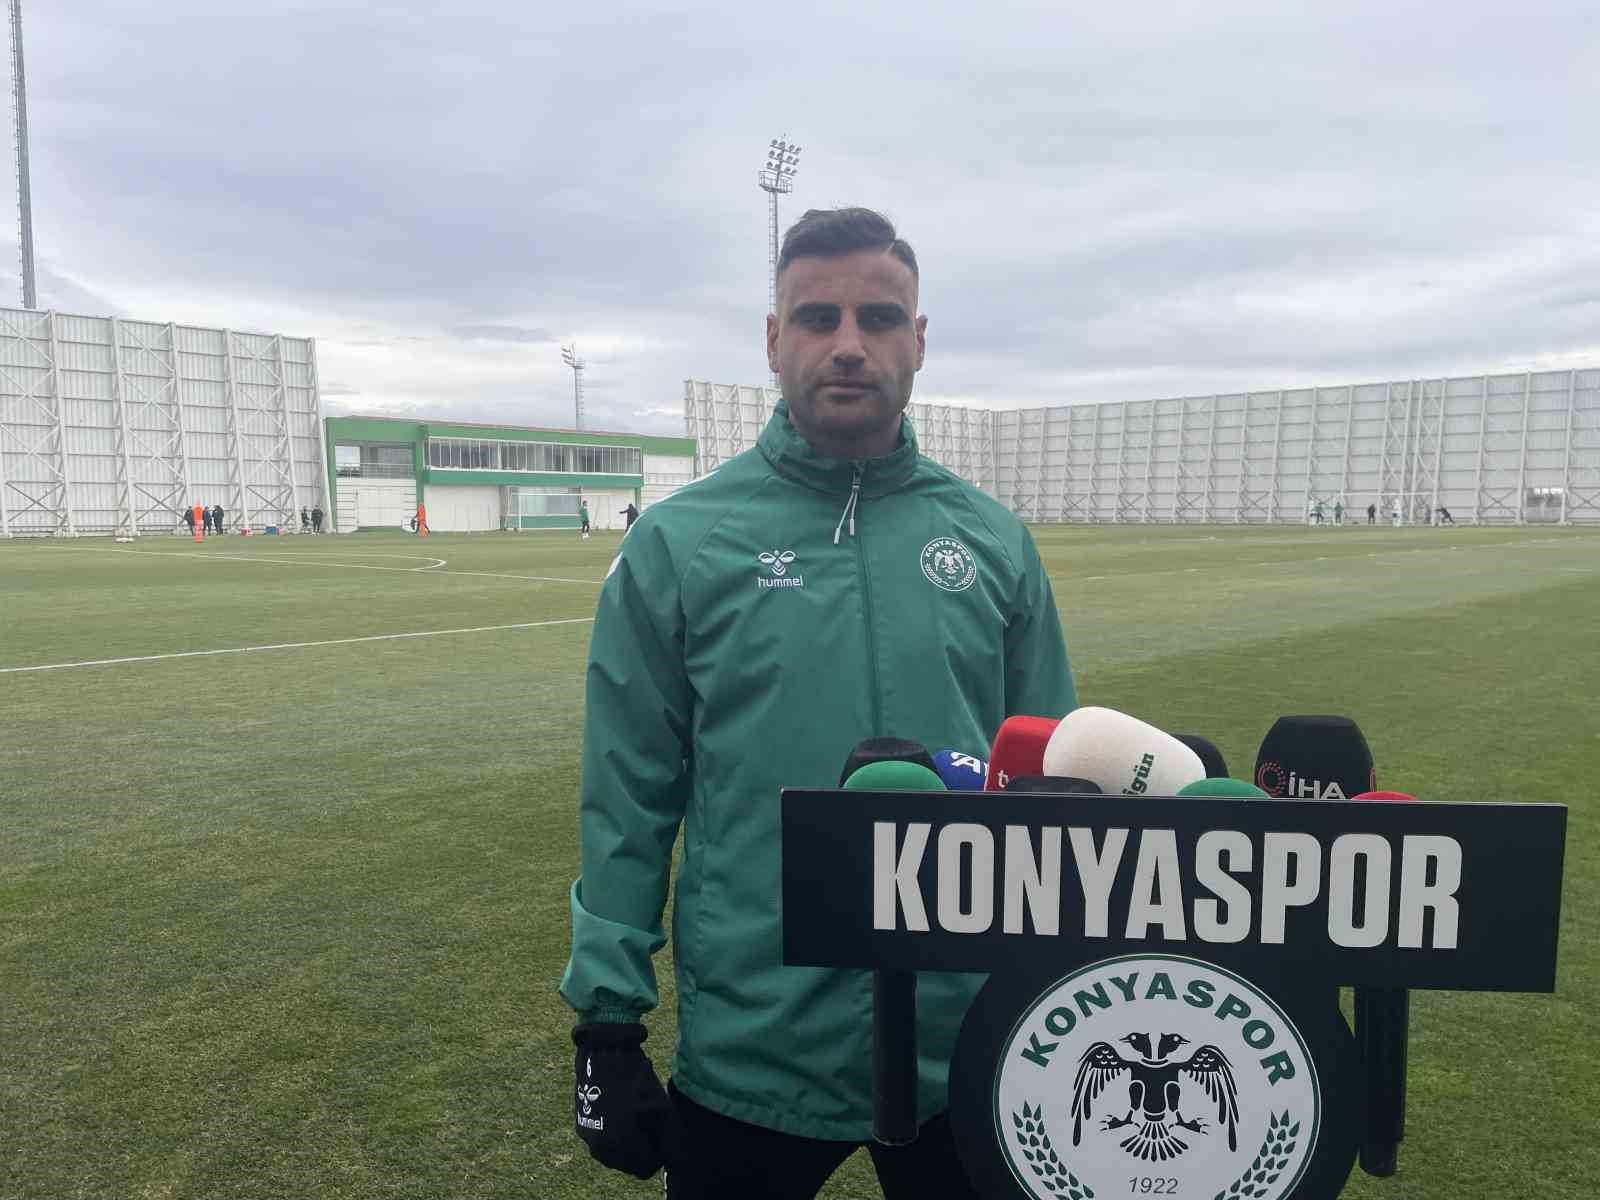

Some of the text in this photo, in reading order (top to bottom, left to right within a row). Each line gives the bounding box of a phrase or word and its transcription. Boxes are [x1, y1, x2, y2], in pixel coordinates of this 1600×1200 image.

[758, 576, 804, 588] hummel
[873, 822, 1463, 950] KONYASPOR
[1020, 972, 1296, 1087] KONYASPOR
[1128, 1177, 1179, 1195] 1922
